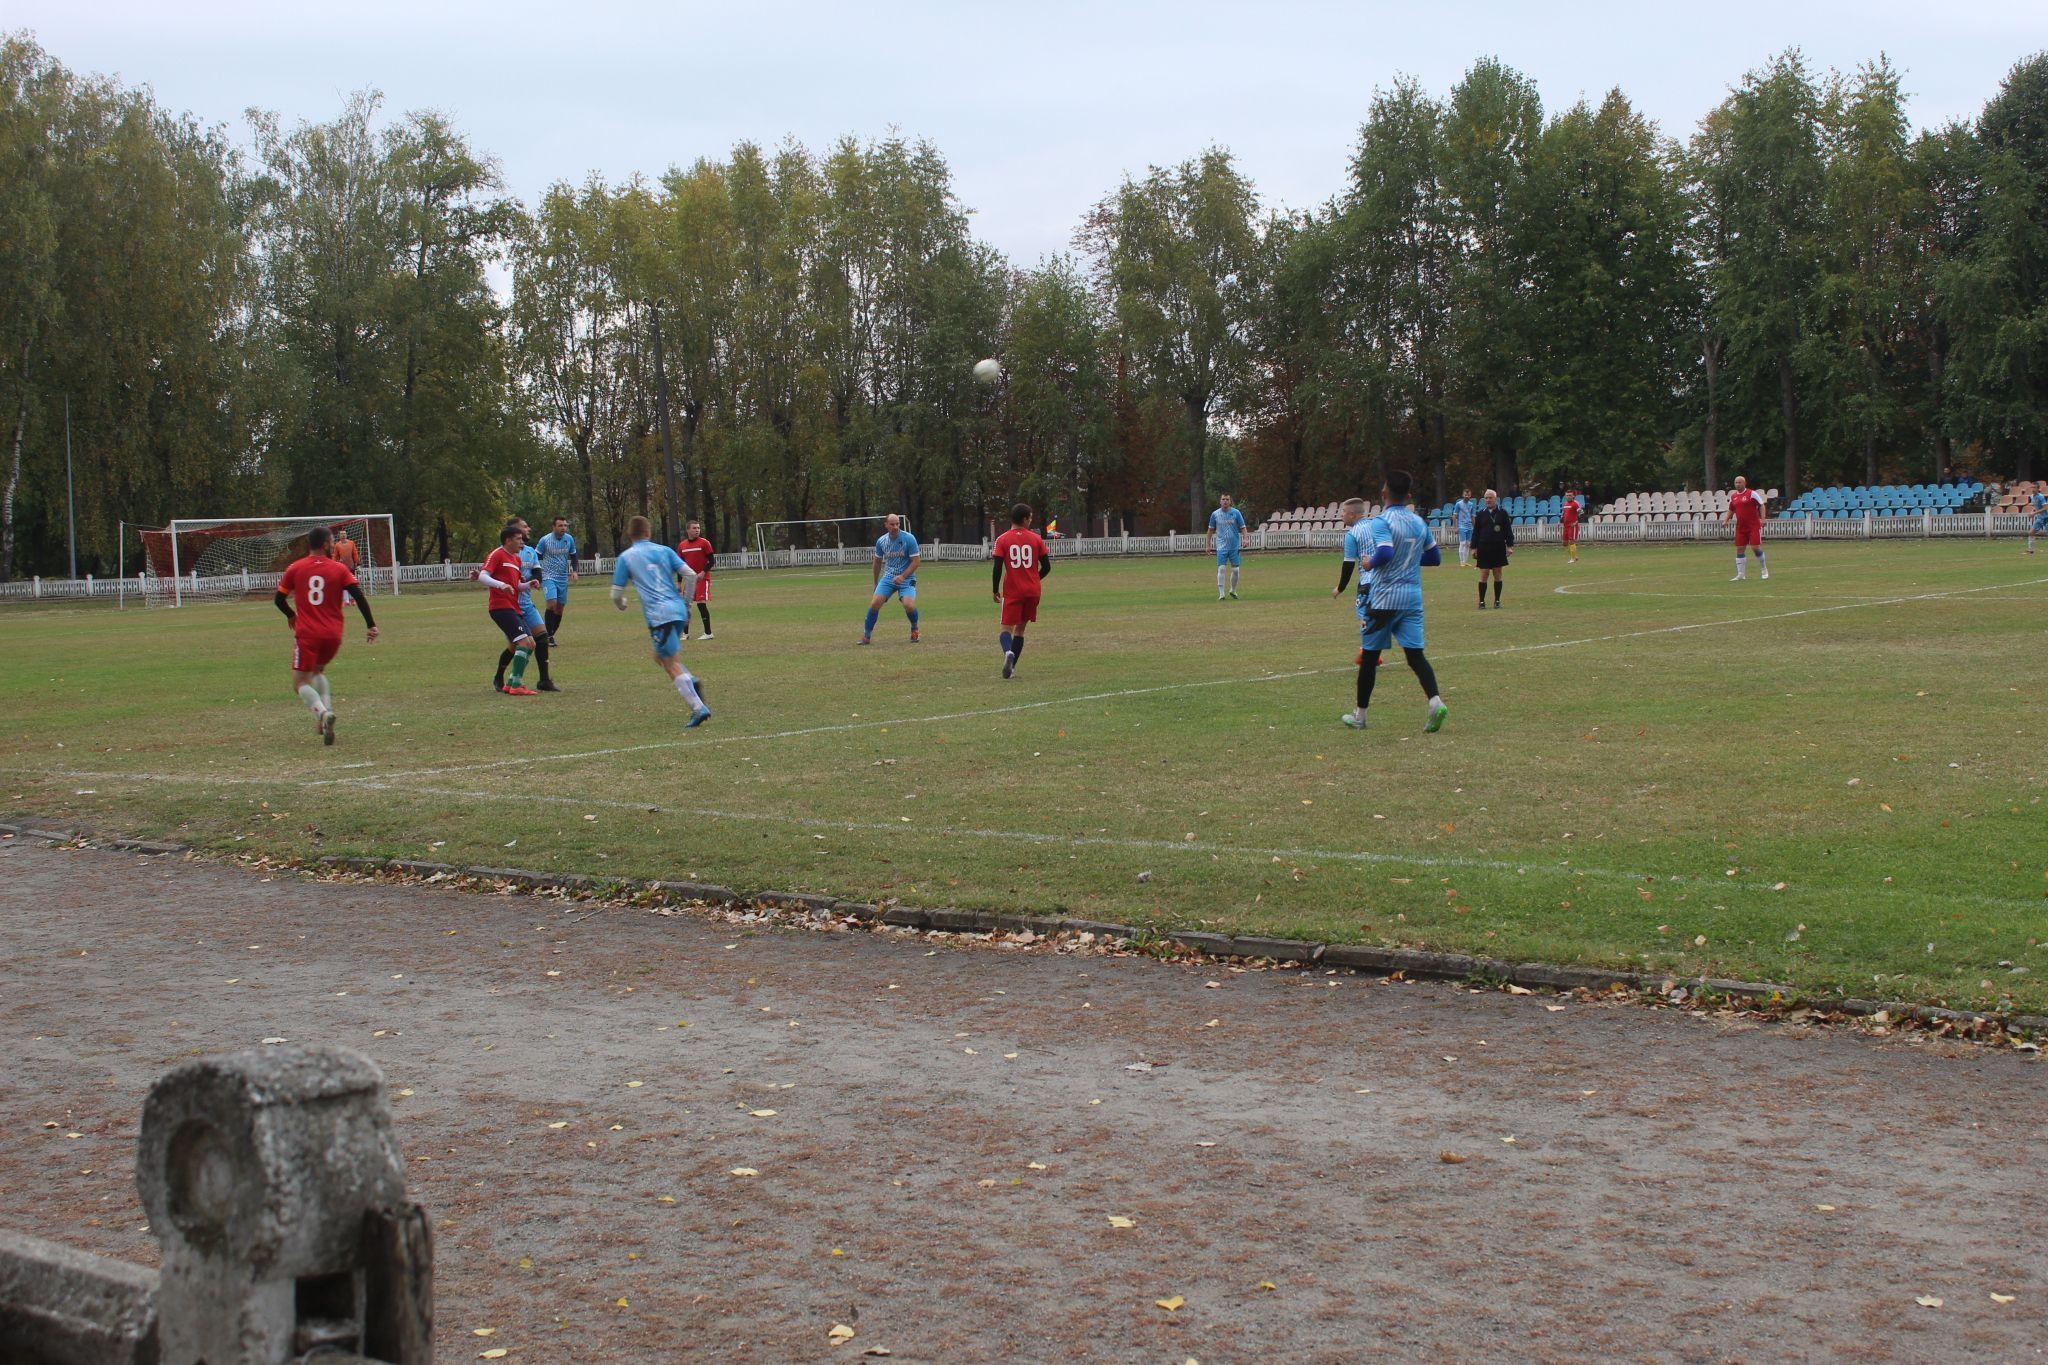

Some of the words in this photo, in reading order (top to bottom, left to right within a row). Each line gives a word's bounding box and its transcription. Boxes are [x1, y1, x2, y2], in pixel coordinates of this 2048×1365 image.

[1009, 544, 1033, 569] 99
[1403, 537, 1416, 570] 7
[307, 575, 325, 606] 8
